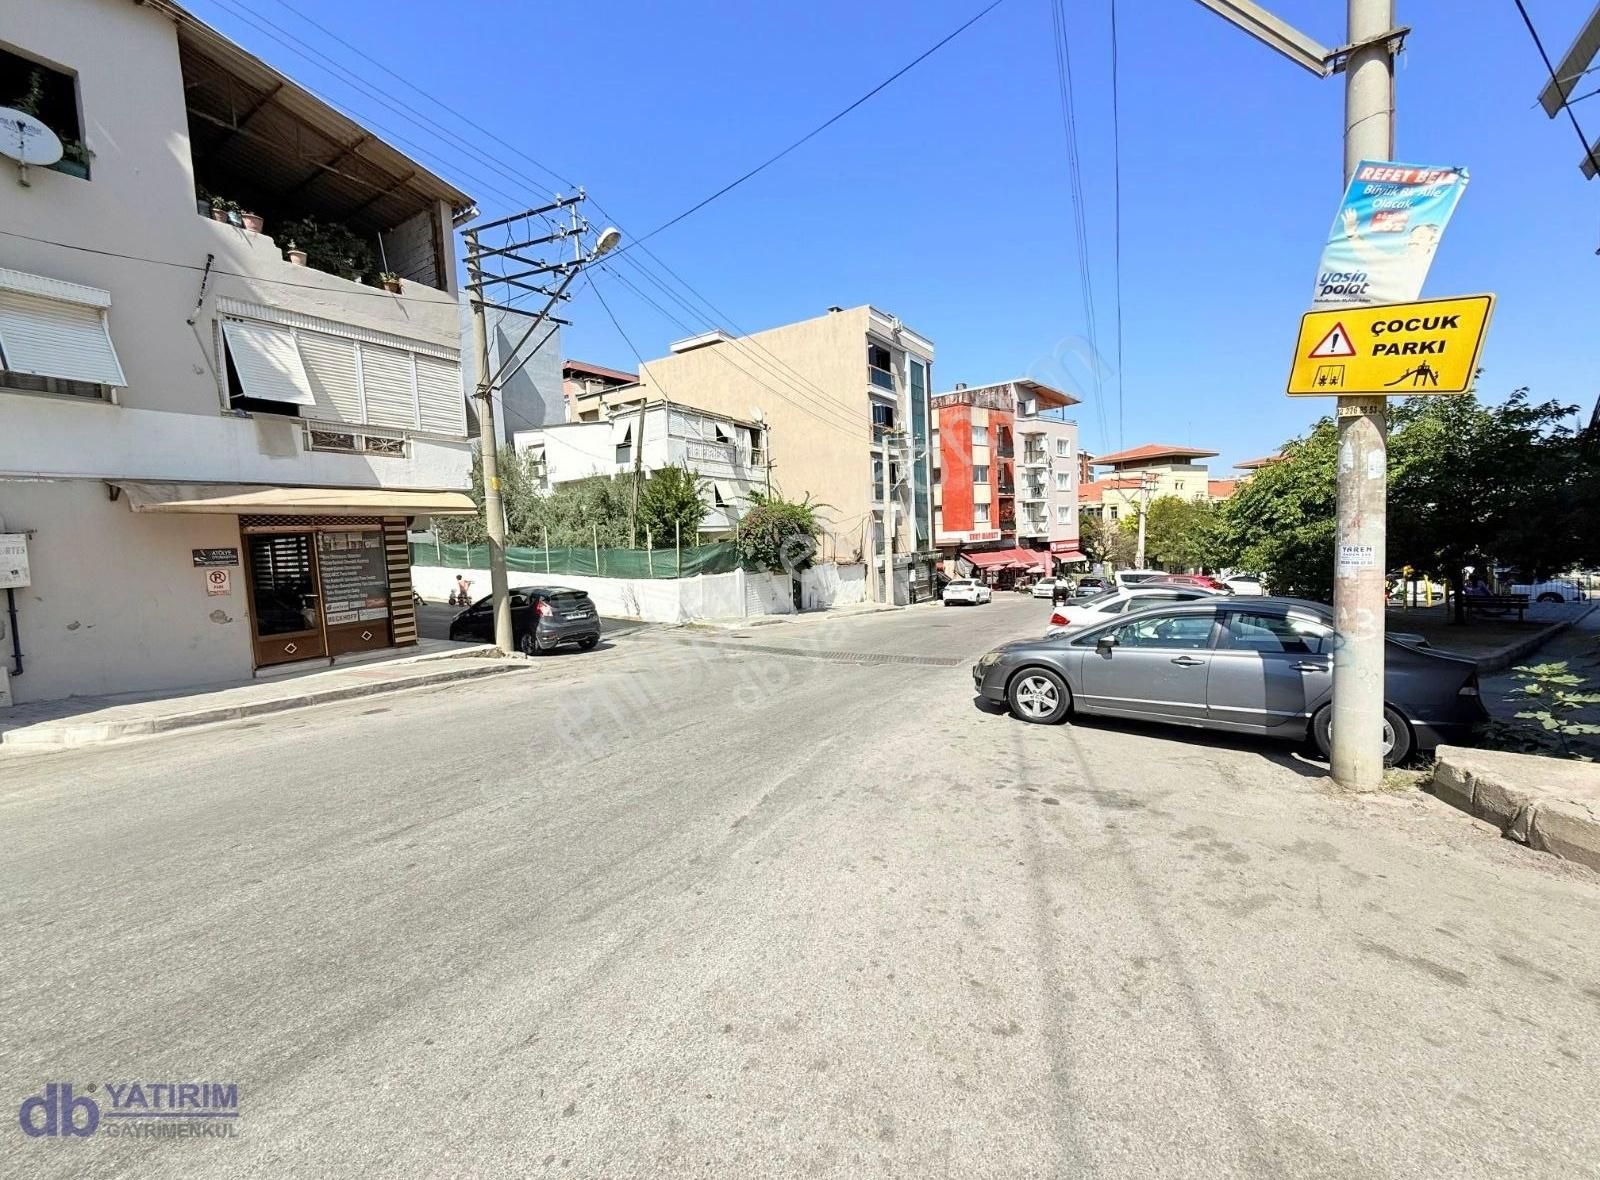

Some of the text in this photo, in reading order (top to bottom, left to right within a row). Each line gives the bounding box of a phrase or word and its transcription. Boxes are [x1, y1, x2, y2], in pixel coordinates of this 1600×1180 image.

[1359, 166, 1413, 183] REFET
[1320, 283, 1370, 297] polat
[1371, 315, 1461, 337] ÇOCUK
[1372, 340, 1446, 356] PARKI
